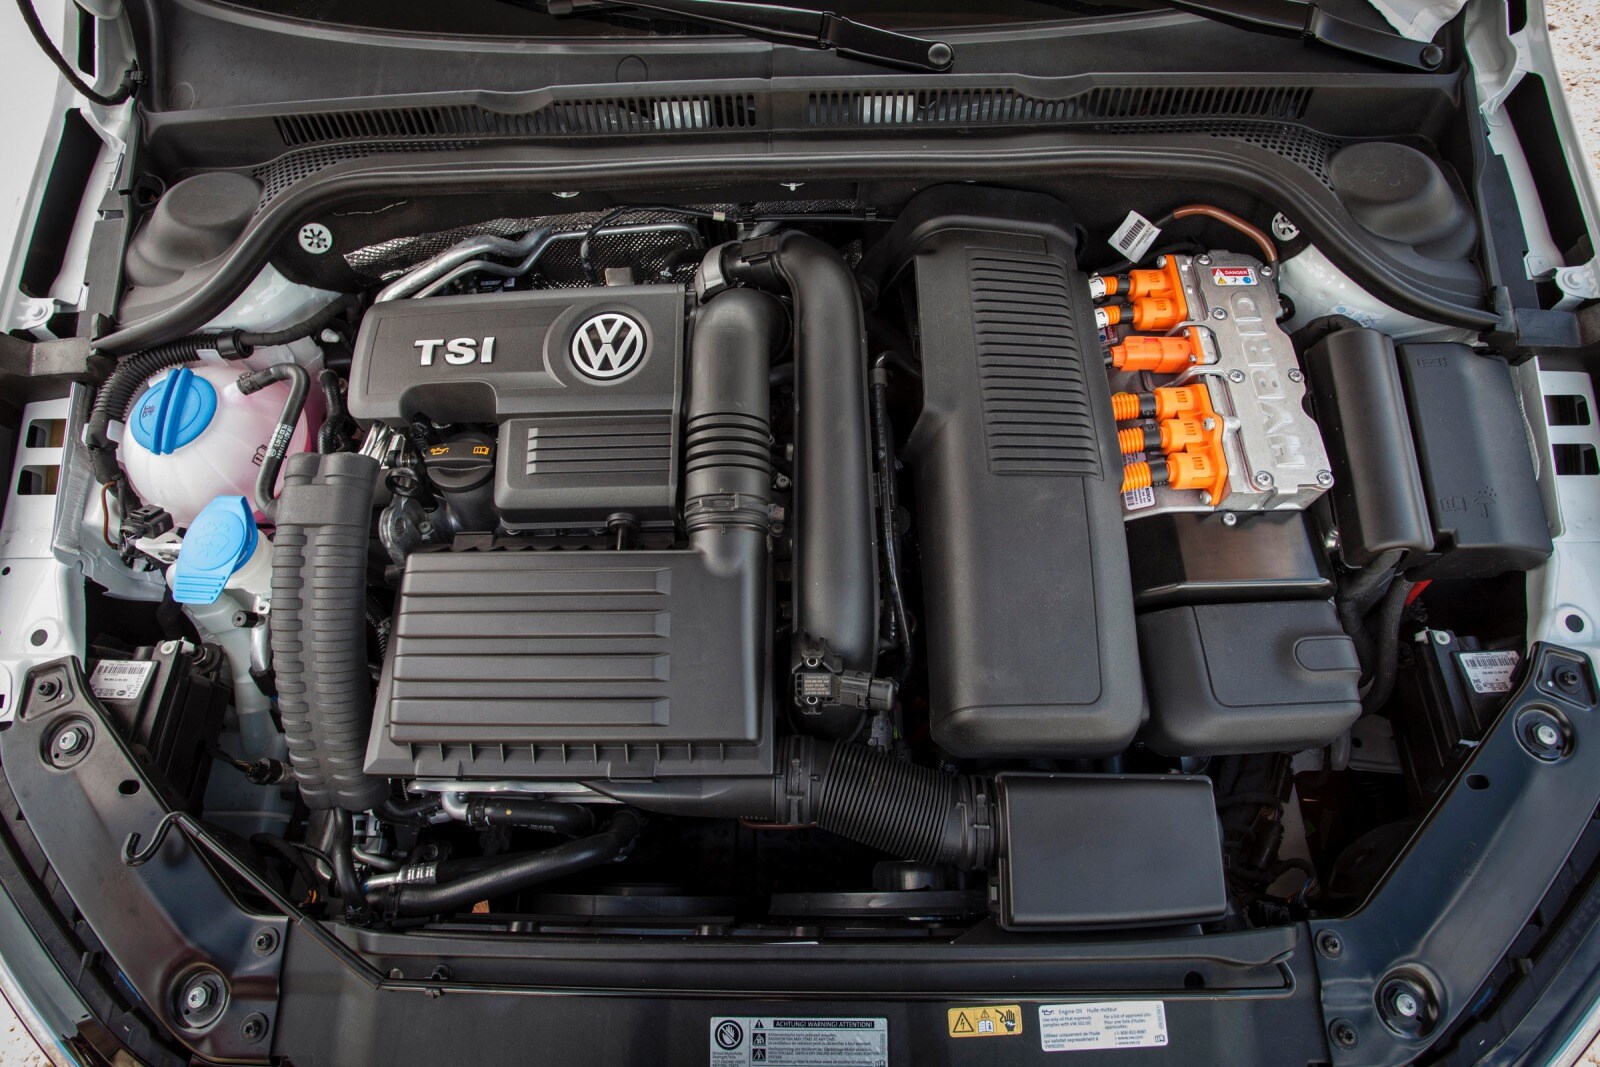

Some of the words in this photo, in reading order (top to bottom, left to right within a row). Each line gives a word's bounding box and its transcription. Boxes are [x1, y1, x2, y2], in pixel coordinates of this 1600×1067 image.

[413, 336, 497, 367] TSI
[571, 312, 645, 378] VW
[1230, 292, 1306, 468] HYBRID
